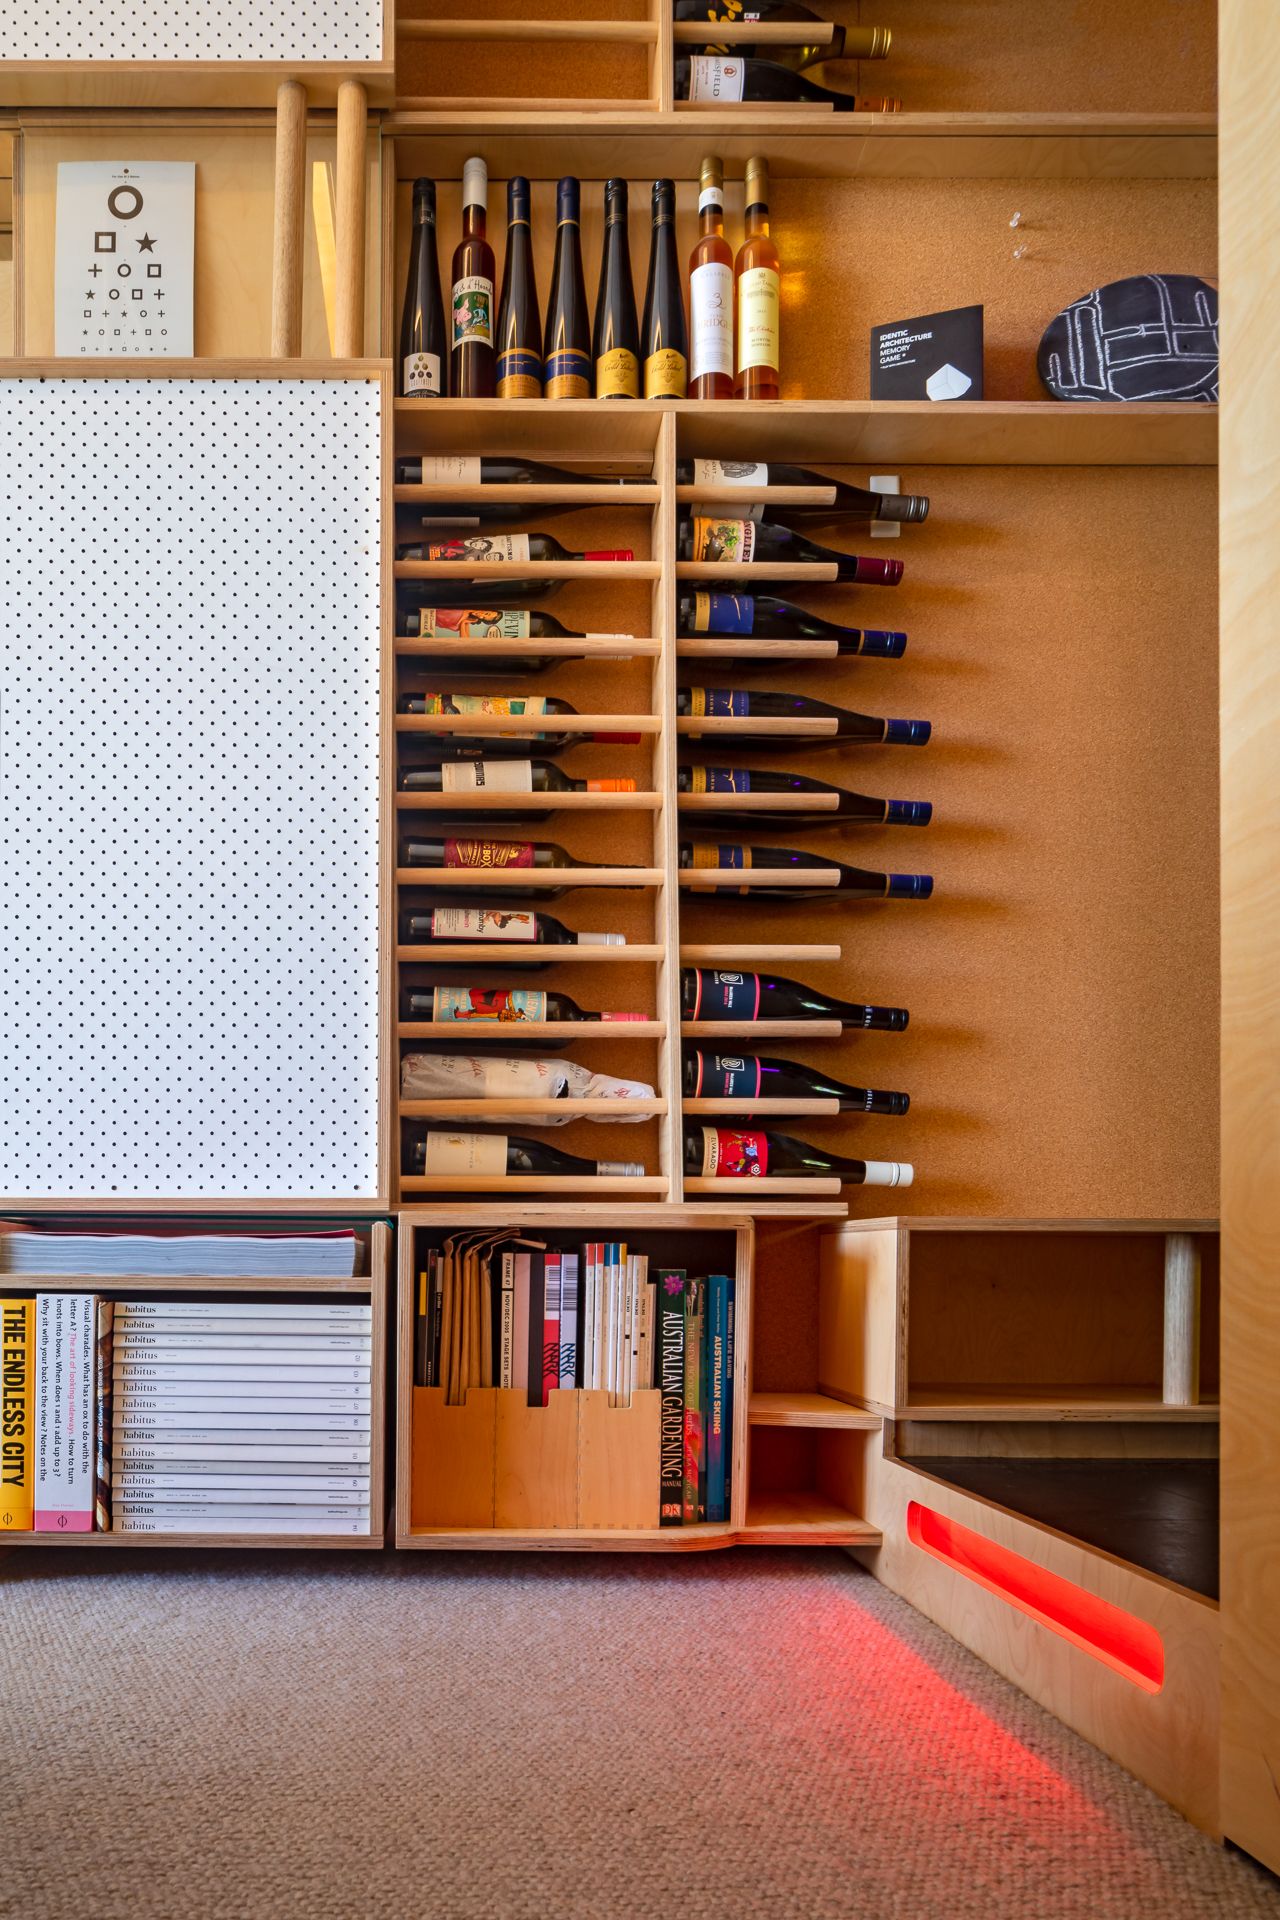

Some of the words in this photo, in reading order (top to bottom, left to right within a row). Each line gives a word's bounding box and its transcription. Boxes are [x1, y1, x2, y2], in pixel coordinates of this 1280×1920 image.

[880, 329, 909, 341] IDENTIC
[880, 332, 932, 349] ARCHITECTURE
[880, 344, 911, 356] MEMORY
[880, 354, 901, 364] GAME
[481, 850, 491, 867] BOX
[41, 1299, 49, 1315] Why
[125, 1305, 156, 1313] habitus
[4, 1306, 26, 1343] THE
[687, 1323, 695, 1341] THE
[124, 1350, 158, 1359] habitus
[662, 1311, 683, 1392] AUSTRALIAN
[687, 1343, 695, 1365] NEW
[70, 1361, 76, 1369] of
[543, 1342, 559, 1379] MARK
[560, 1343, 576, 1379] MARK
[122, 1366, 157, 1375] habitus
[713, 1336, 722, 1398] AUSTRALIAN
[687, 1366, 695, 1392] BOOK
[68, 1371, 76, 1400] looking
[123, 1382, 157, 1391] habitus
[3, 1349, 25, 1436] ENDLESS
[83, 1399, 89, 1408] an
[122, 1399, 157, 1408] habitus
[687, 1393, 694, 1406] OF
[67, 1401, 76, 1437] sideways.
[83, 1411, 88, 1419] ox
[121, 1415, 156, 1424] habitus
[713, 1400, 721, 1434] SKIING
[83, 1421, 88, 1429] to
[686, 1407, 695, 1435] Herbs
[82, 1431, 89, 1440] do
[123, 1431, 155, 1439] habitus
[661, 1396, 682, 1477] GARDENING
[53, 1447, 59, 1457] up
[121, 1448, 155, 1457] habitus
[3, 1442, 25, 1487] CITY
[40, 1457, 46, 1467] on
[68, 1458, 74, 1466] to
[123, 1462, 154, 1470] habitus
[121, 1475, 155, 1484] habitus
[123, 1490, 154, 1498] habitus
[123, 1506, 154, 1514] habitus
[662, 1504, 681, 1517] DK
[121, 1521, 156, 1530] habitus
